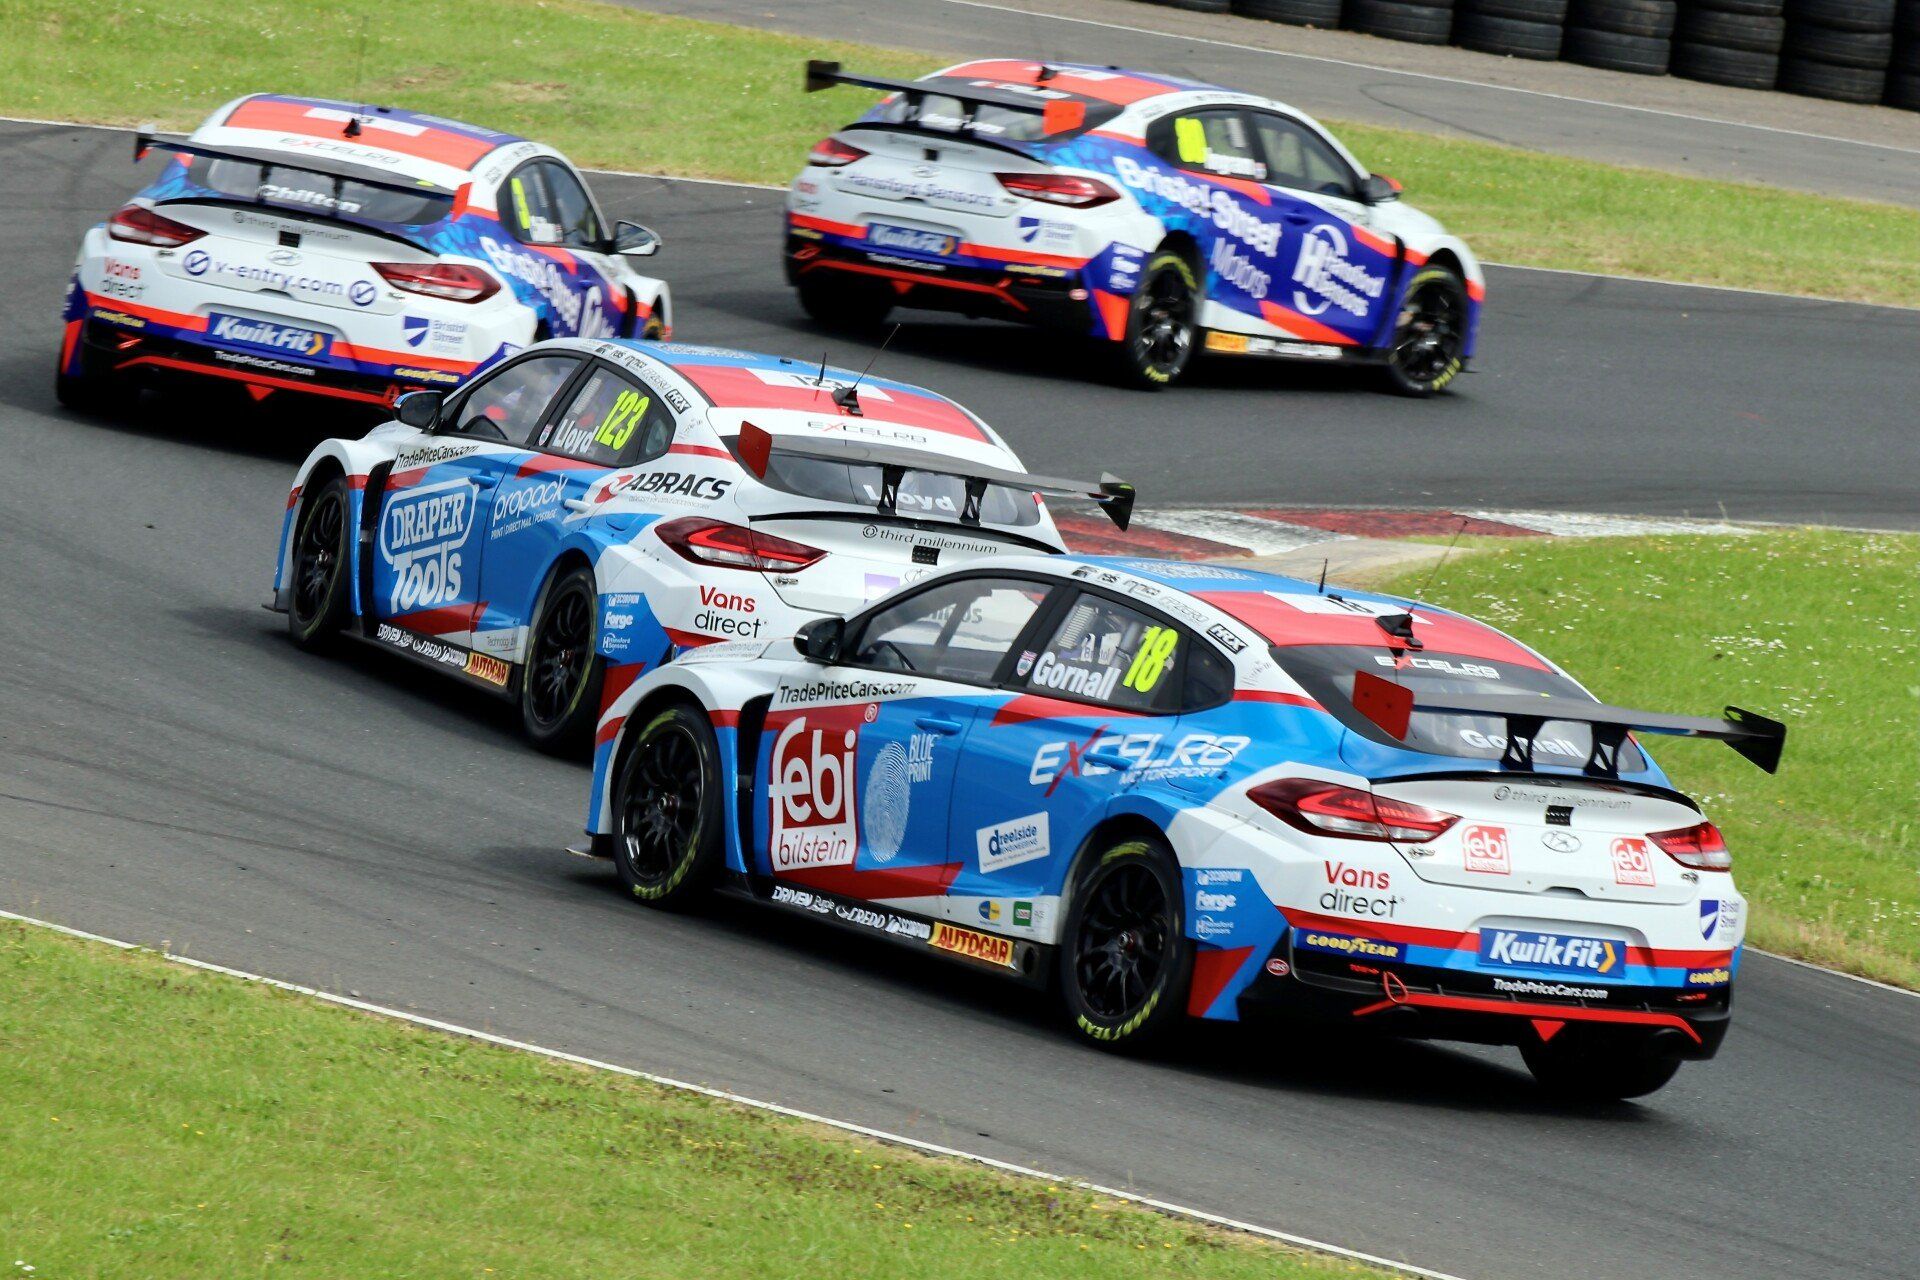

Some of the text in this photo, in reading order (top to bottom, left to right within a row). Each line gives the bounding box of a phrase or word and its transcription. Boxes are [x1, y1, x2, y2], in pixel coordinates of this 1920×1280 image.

[215, 261, 344, 295] v-entry.com
[595, 389, 650, 451] 123
[554, 418, 599, 454] Lloyd
[397, 445, 479, 468] TradePriceCars.com
[492, 472, 568, 528] propack
[619, 472, 733, 500] ABRACS
[391, 492, 466, 550] DRAPER
[880, 530, 998, 554] third millennium
[391, 542, 462, 614] Tools
[700, 585, 756, 613] Vans
[694, 610, 762, 638] direct
[1211, 623, 1246, 653] HRX
[470, 655, 507, 683] AUTOCAR
[1123, 625, 1179, 693] 18
[1032, 652, 1122, 700] Gornall
[780, 680, 917, 703] TradePriceCars.com
[908, 732, 937, 762] BLUE
[768, 716, 857, 828] febi
[908, 760, 933, 784] PRINT
[779, 831, 847, 866] bilstein
[1463, 825, 1508, 860] febi
[1325, 860, 1390, 890] Vans
[1319, 888, 1397, 918] direct
[938, 925, 1010, 963] AUTOCAR
[1306, 934, 1399, 958] GOODYEAR
